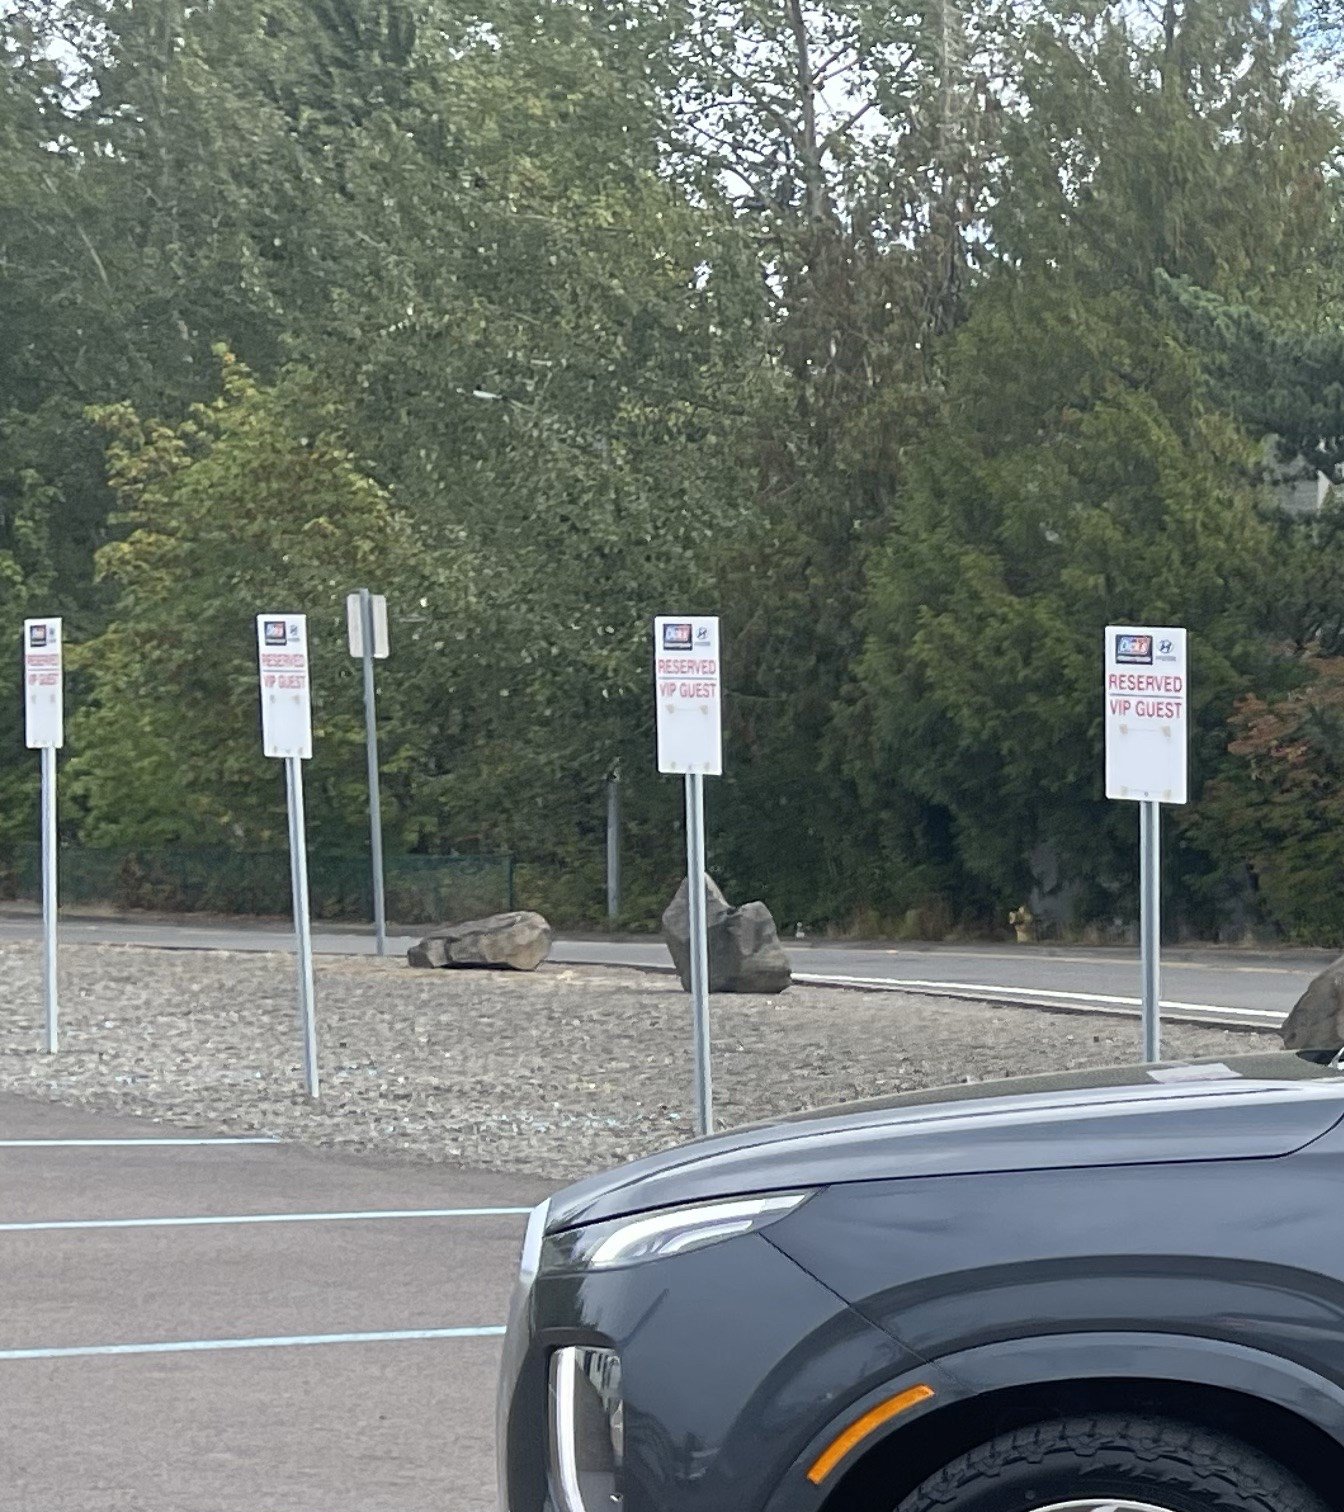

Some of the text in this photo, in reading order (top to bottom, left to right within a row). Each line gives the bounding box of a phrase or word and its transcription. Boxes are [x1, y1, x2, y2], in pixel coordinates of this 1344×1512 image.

[657, 659, 717, 675] RESERVED
[659, 682, 717, 699] VIP GUEST
[1108, 674, 1183, 693] RESERVED
[1109, 700, 1183, 719] VIP GUEST
